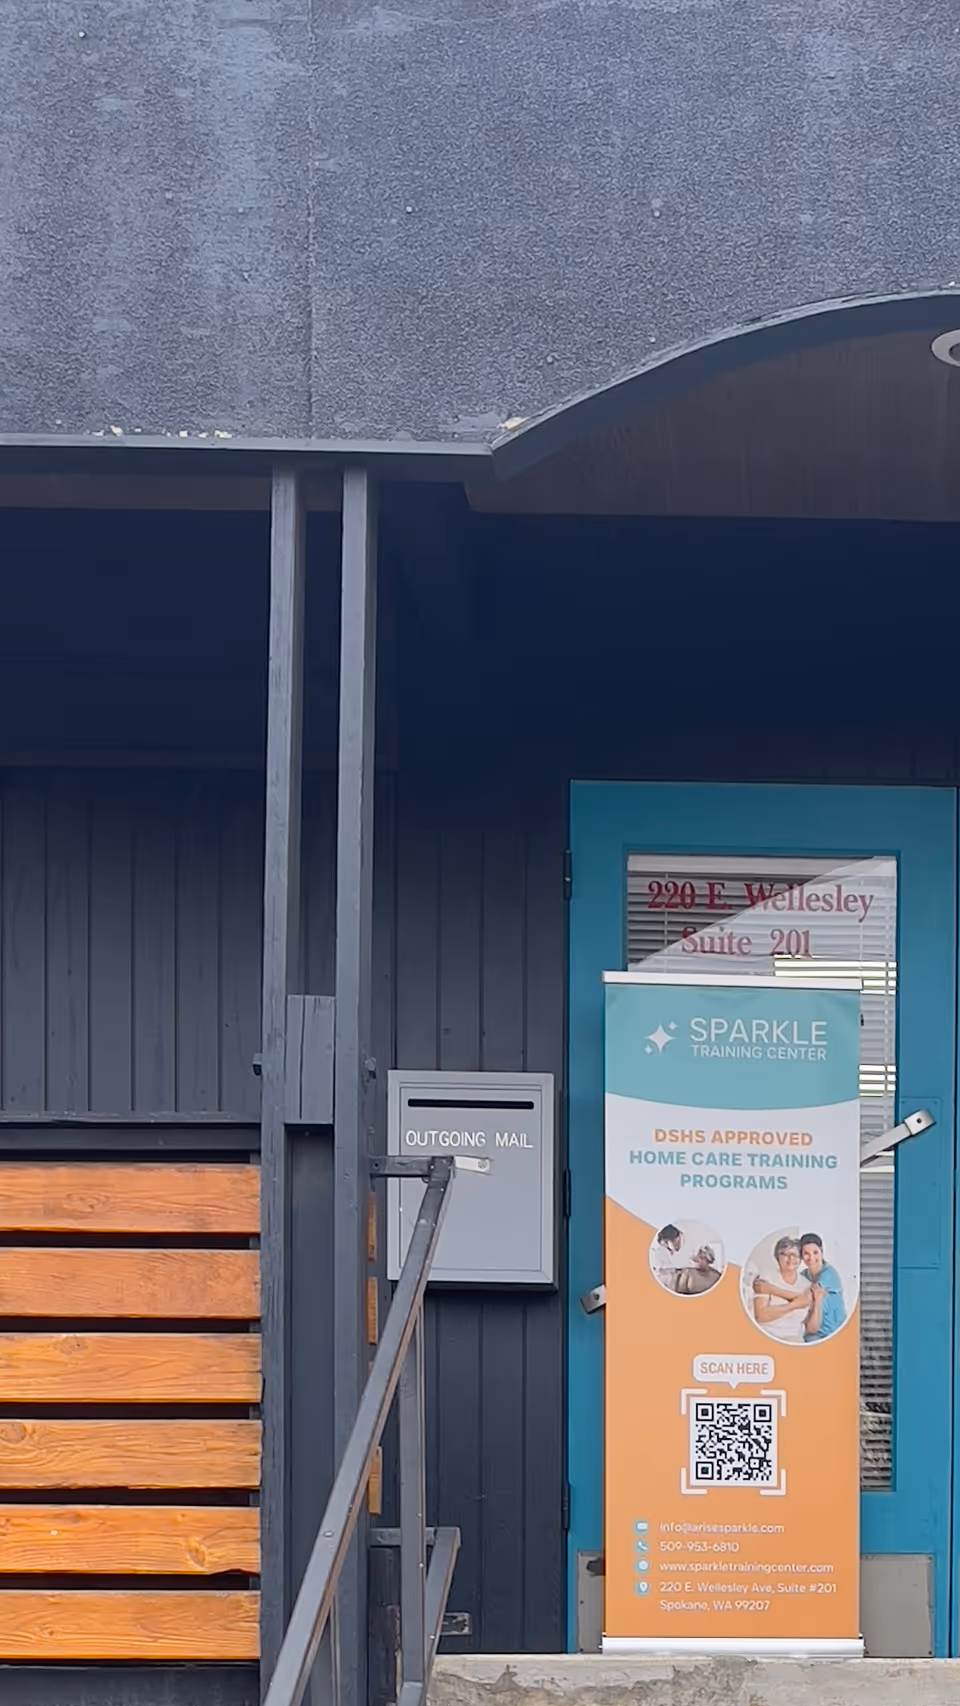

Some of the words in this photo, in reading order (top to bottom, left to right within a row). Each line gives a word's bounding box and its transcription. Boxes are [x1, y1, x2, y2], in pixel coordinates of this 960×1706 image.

[647, 881, 696, 910] 220
[706, 882, 732, 911] E.
[744, 882, 874, 922] Wellesley
[682, 926, 752, 955] Suite
[769, 929, 813, 957] 201
[689, 1017, 828, 1046] SPARKLE
[690, 1044, 762, 1060] TRAINING
[767, 1046, 828, 1061] CENTER
[405, 1130, 486, 1147] OUTGOING
[495, 1132, 534, 1148] MAIL
[654, 1128, 706, 1144] DSHS
[711, 1130, 813, 1146] APPROVED
[629, 1151, 686, 1166] HOME
[691, 1152, 743, 1167] CARE
[747, 1153, 838, 1169] TRAINING
[680, 1174, 788, 1190] PROGRAMS
[700, 1362, 734, 1374] SCAN
[737, 1363, 769, 1375] HERE
[660, 1541, 739, 1552] 509-953-6810
[659, 1560, 834, 1575] www.sparkletrainingcenter.com
[660, 1581, 682, 1592] 220
[697, 1582, 748, 1595] Wellesley
[777, 1583, 806, 1593] Suite
[809, 1583, 837, 1593] #201
[713, 1600, 733, 1610] WA
[735, 1600, 770, 1610] 99207
